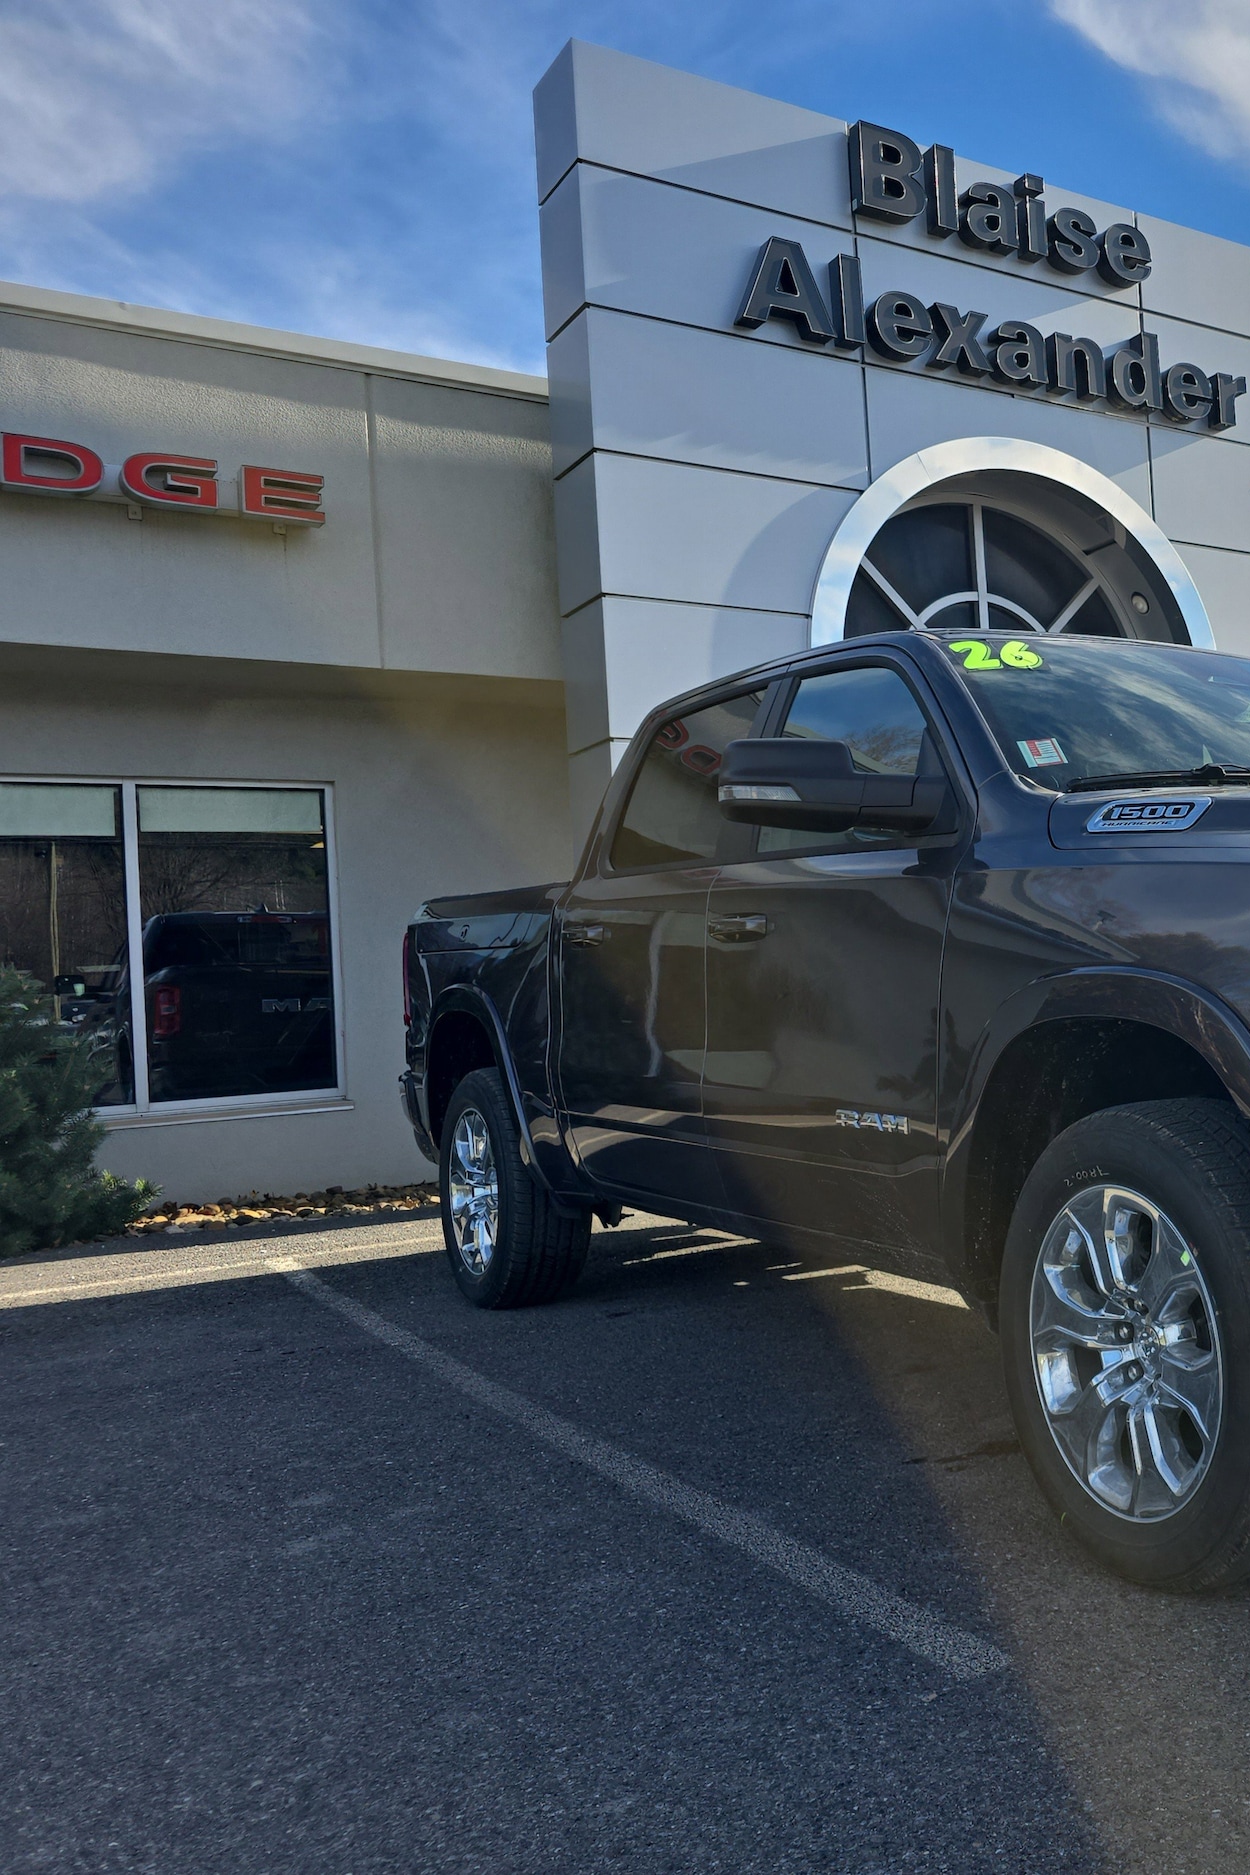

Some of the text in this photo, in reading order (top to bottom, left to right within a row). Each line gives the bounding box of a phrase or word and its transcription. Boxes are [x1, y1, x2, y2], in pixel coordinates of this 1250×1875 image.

[849, 120, 1152, 288] Blaise
[735, 236, 1247, 431] Alexander
[948, 640, 1043, 671] 26
[1110, 805, 1190, 819] 1500
[835, 1108, 910, 1135] RAM
